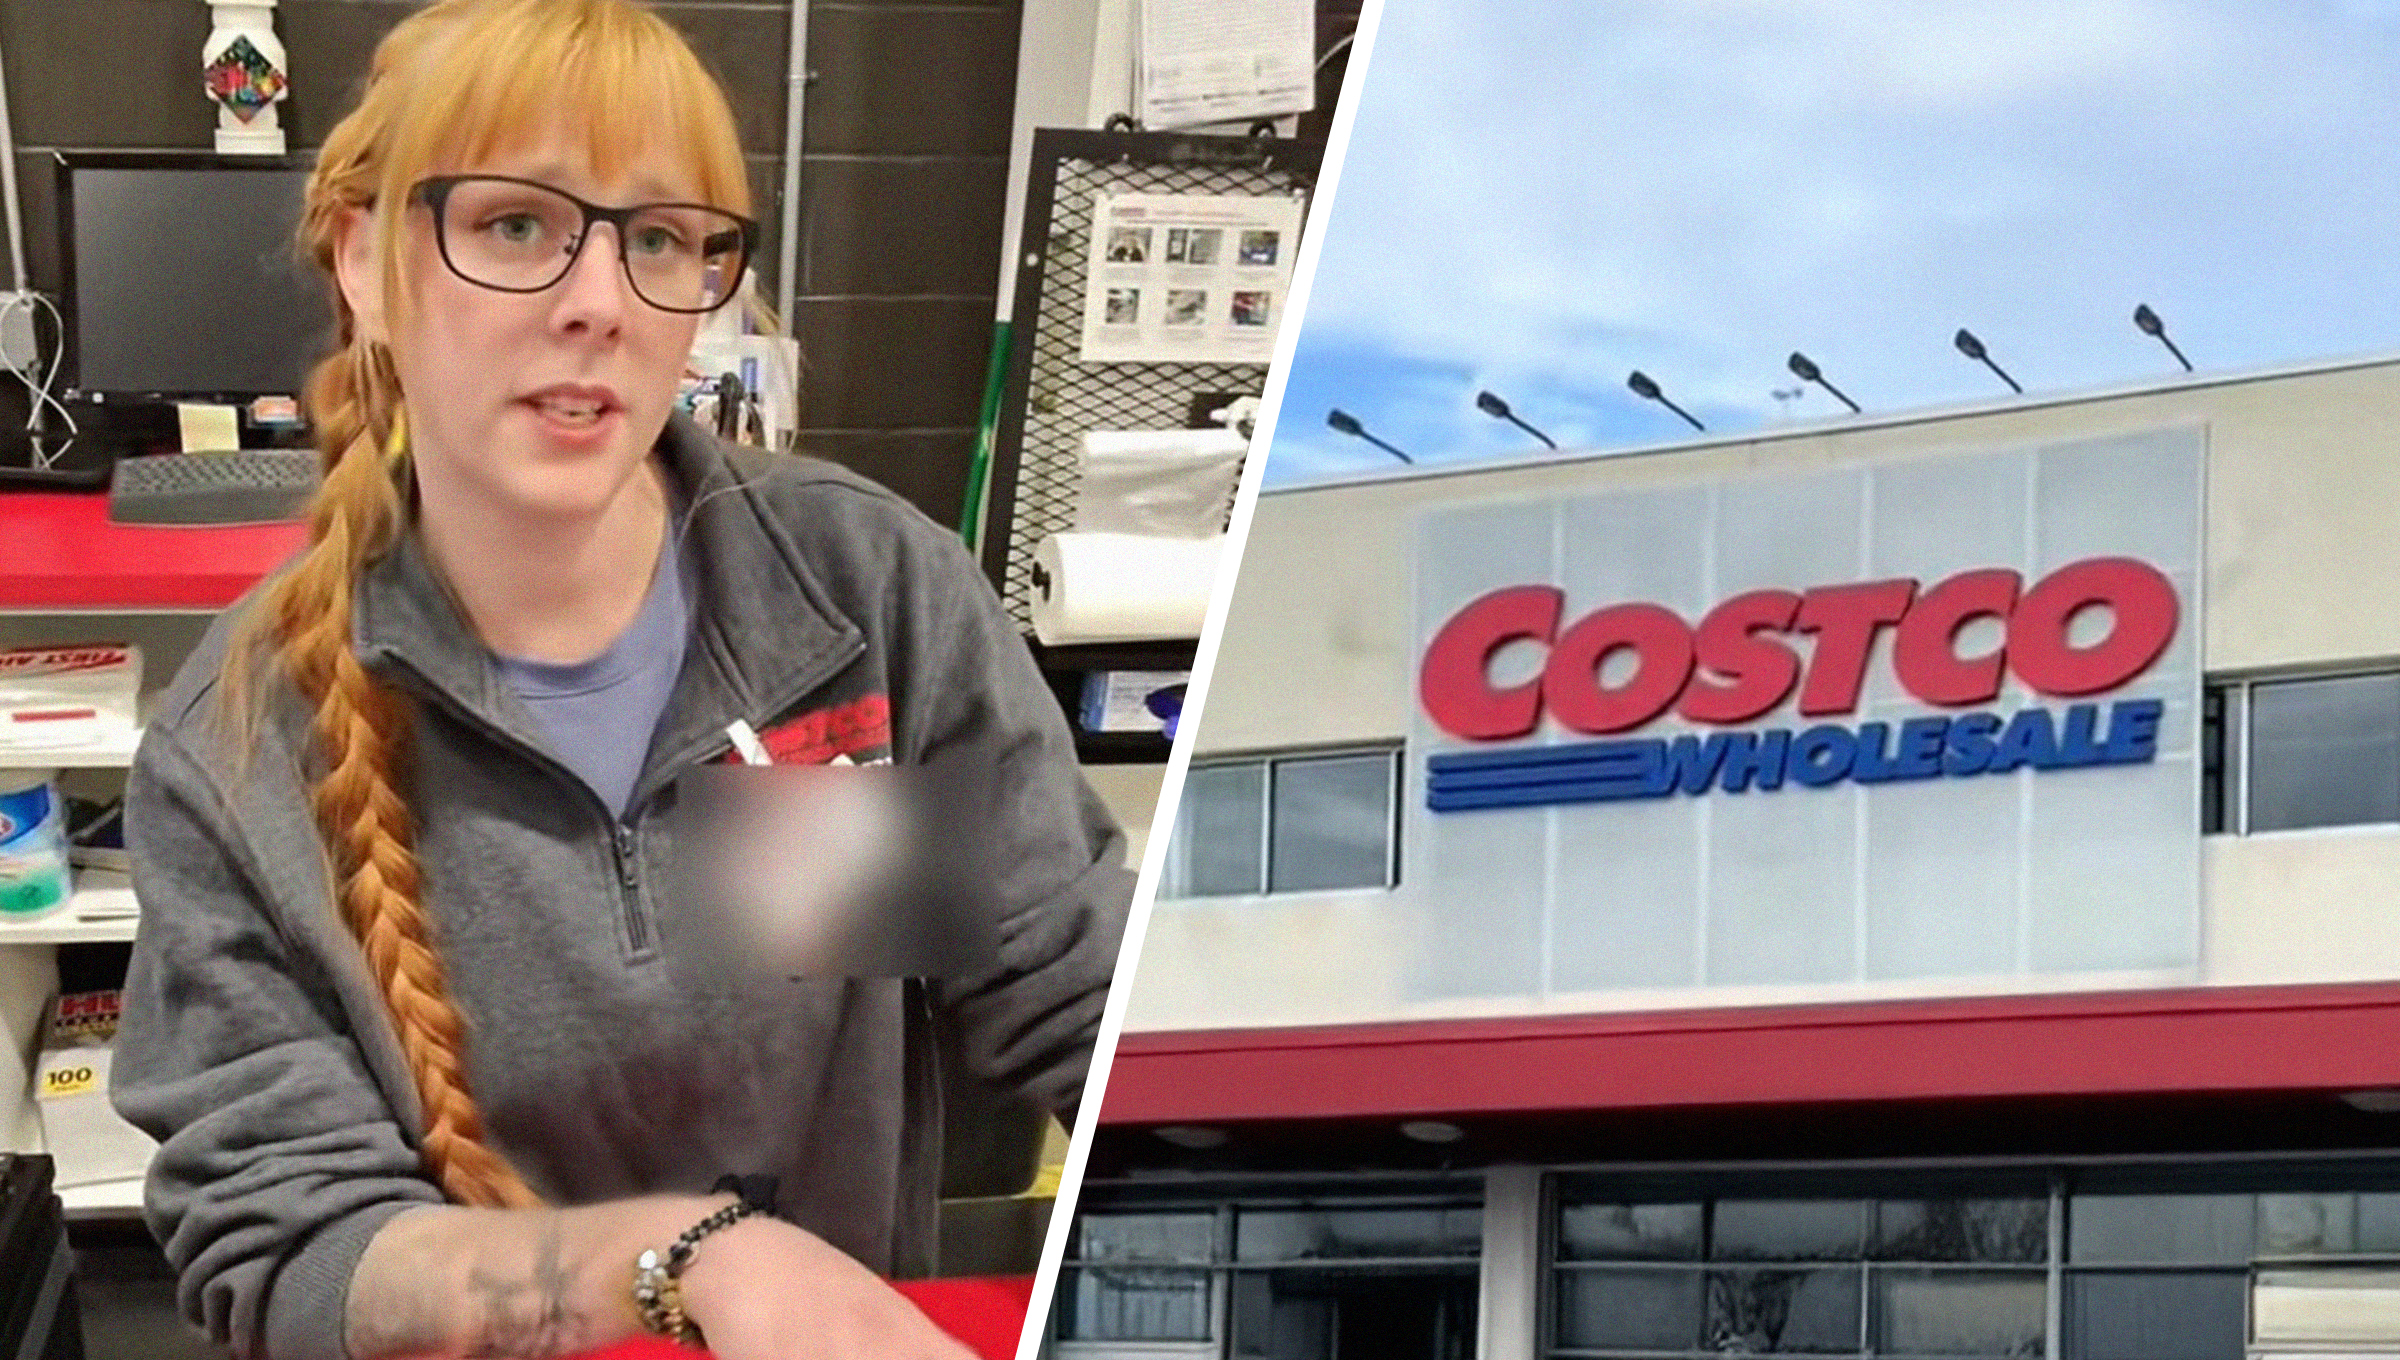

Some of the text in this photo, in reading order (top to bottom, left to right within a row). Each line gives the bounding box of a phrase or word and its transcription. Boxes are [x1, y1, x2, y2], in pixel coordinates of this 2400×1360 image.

[1418, 556, 2180, 743] COSTCO
[1648, 699, 2163, 798] WHOLESALE
[49, 1067, 92, 1086] 100
